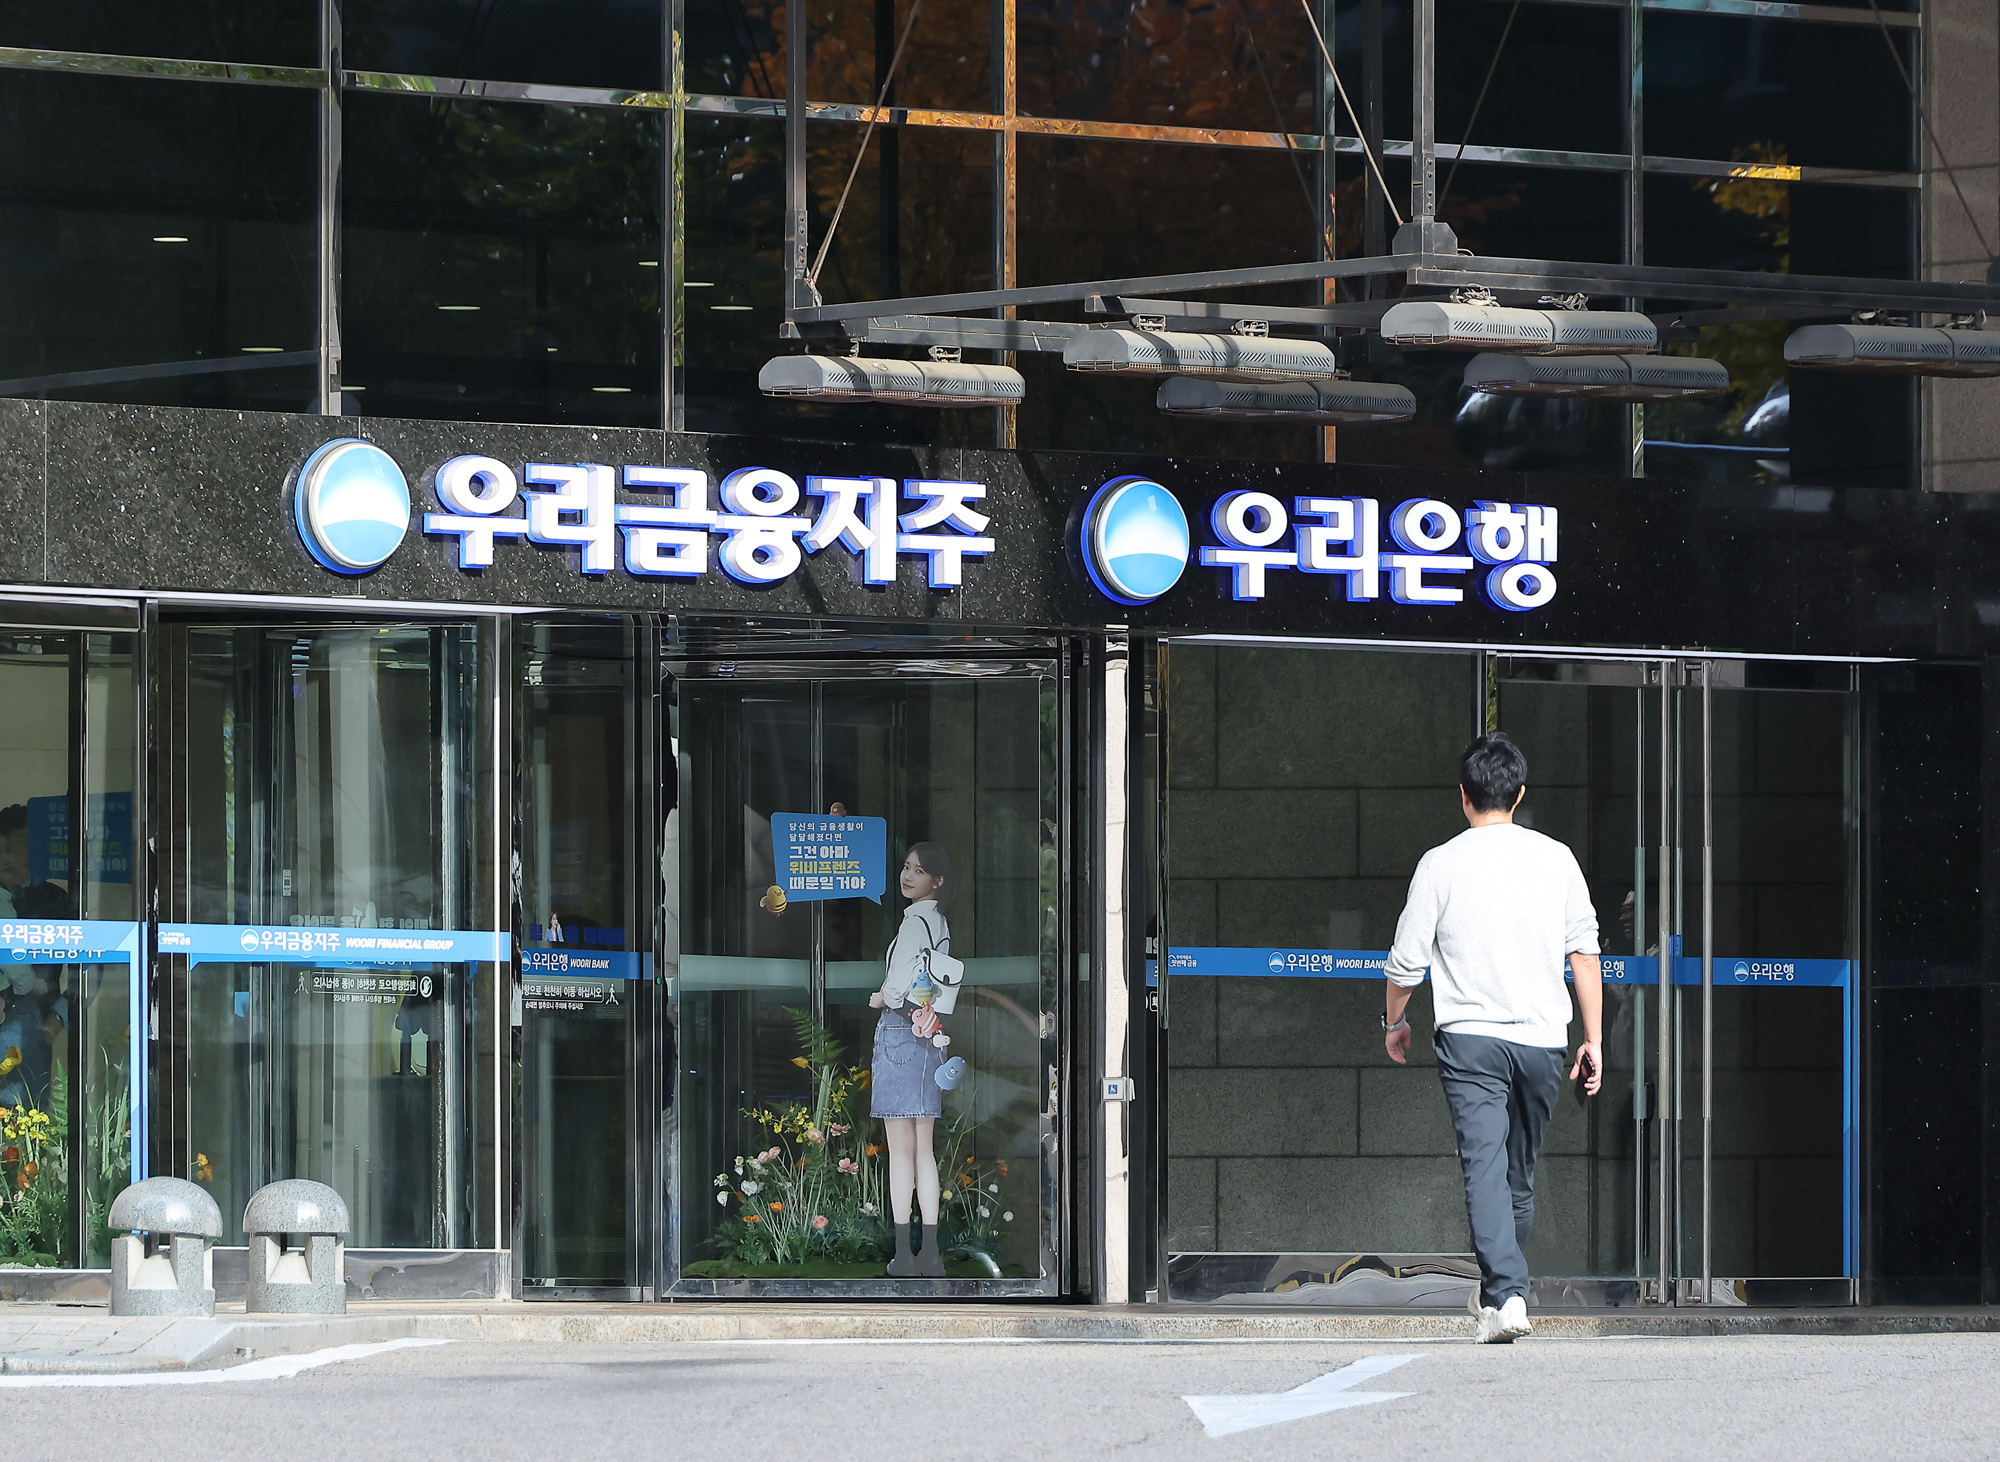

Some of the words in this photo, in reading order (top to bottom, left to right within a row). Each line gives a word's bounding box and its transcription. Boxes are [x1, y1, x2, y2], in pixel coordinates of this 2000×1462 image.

[424, 455, 996, 588] 우리금융지주
[1200, 490, 1558, 612] 우리은행
[789, 822, 815, 831] 당신의
[819, 822, 864, 831] 금융생활이
[789, 845, 817, 859] 그건
[819, 845, 850, 859] 아마
[789, 861, 861, 875] 위비프렌즈
[789, 876, 834, 890] 때문일
[836, 876, 866, 890] 거야
[1, 924, 84, 945] 우리금융지주
[260, 930, 341, 952] 우리금융지주
[345, 937, 376, 948] WOORI
[376, 938, 423, 950] FINANCIAL
[423, 939, 454, 950] GROUP
[532, 953, 569, 972] 우리은행
[570, 958, 591, 968] WOORI
[592, 959, 610, 969] BANK
[1286, 953, 1333, 973] 우리은행
[1336, 959, 1363, 969] WOORI
[1363, 959, 1387, 969] BANK
[1600, 960, 1625, 979] 은행
[1750, 963, 1795, 981] 우리은행
[522, 984, 542, 996] 향으로
[543, 985, 562, 997] 천천히
[563, 986, 576, 998] 이동
[577, 986, 602, 998] 하십시오
